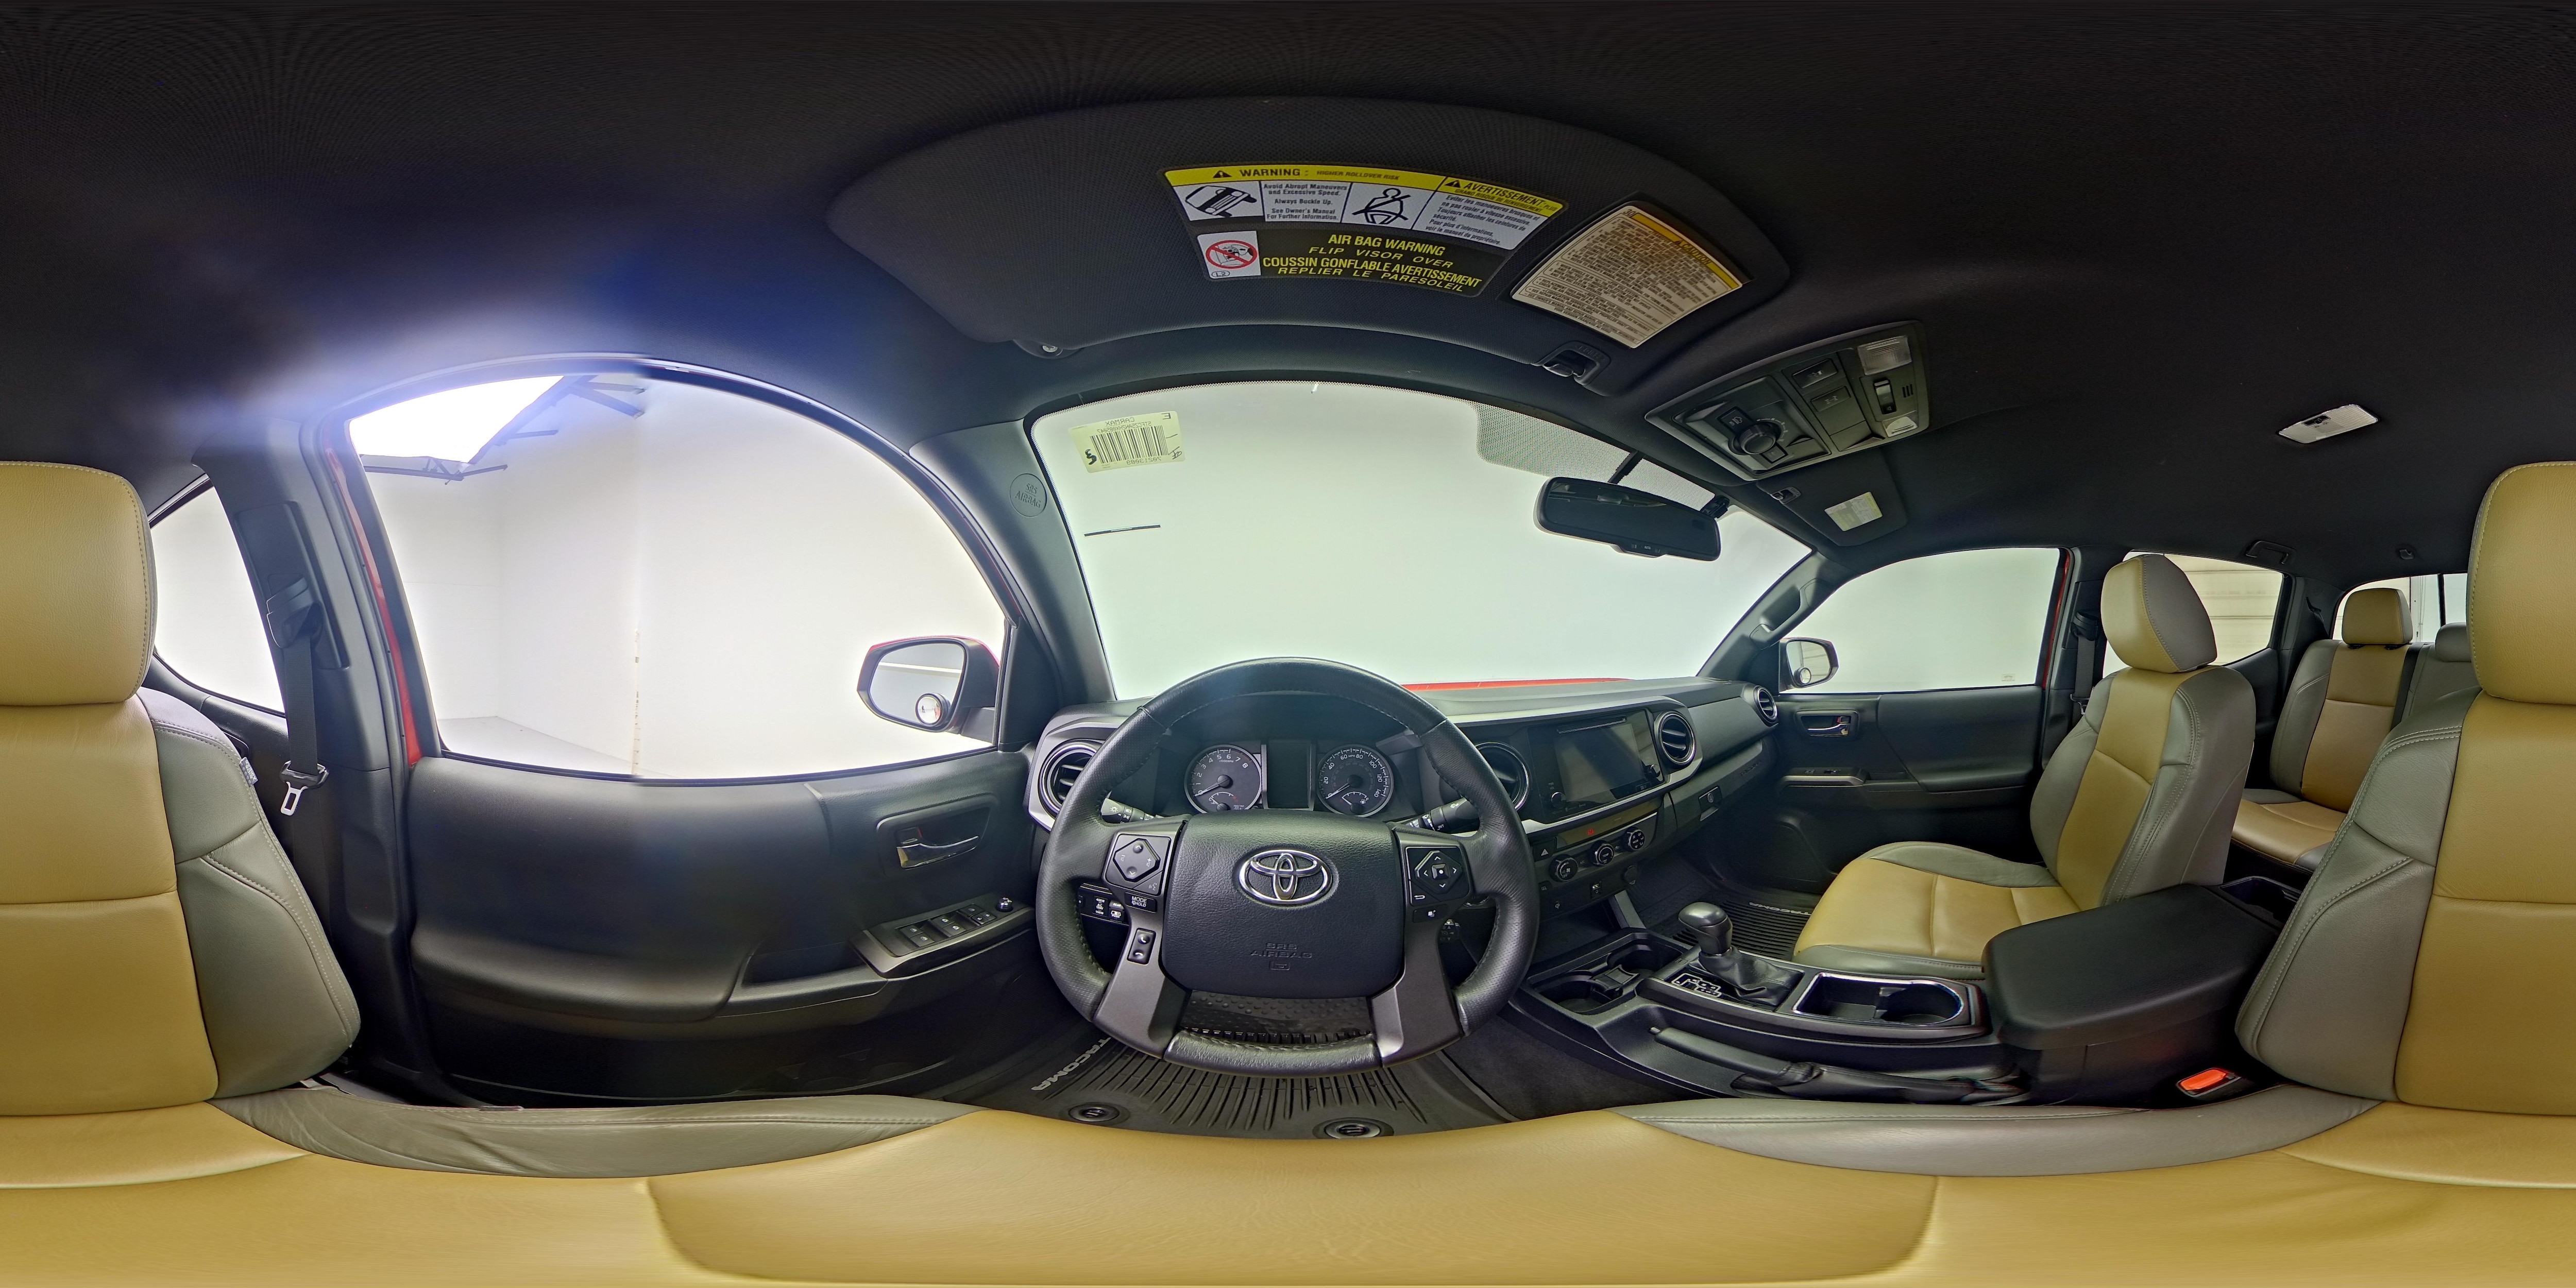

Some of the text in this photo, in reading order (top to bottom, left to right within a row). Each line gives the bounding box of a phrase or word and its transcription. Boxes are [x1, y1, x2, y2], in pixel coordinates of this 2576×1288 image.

[1240, 168, 1300, 177] WARNING
[1437, 207, 1463, 215] Toujours
[1463, 212, 1487, 220] attacher
[1508, 209, 1534, 219] brusques
[1328, 234, 1445, 256] AIR BAG WARNING
[1356, 249, 1403, 260] VISOR
[1413, 257, 1453, 268] OVER
[1681, 243, 1711, 265] CAUTION
[1263, 257, 1482, 287] COUSSIN GONFLABLE AVERTISSEMENT
[1381, 273, 1463, 292] PARESOLEIL
[1025, 483, 1037, 494] SRS
[1015, 491, 1041, 508] AIRBAG
[1328, 762, 1335, 770] 40
[1368, 760, 1377, 769] 100
[1374, 788, 1382, 798] 140
[1250, 950, 1313, 958] AIRBAG
[1031, 1037, 1111, 1091] TACOMA
